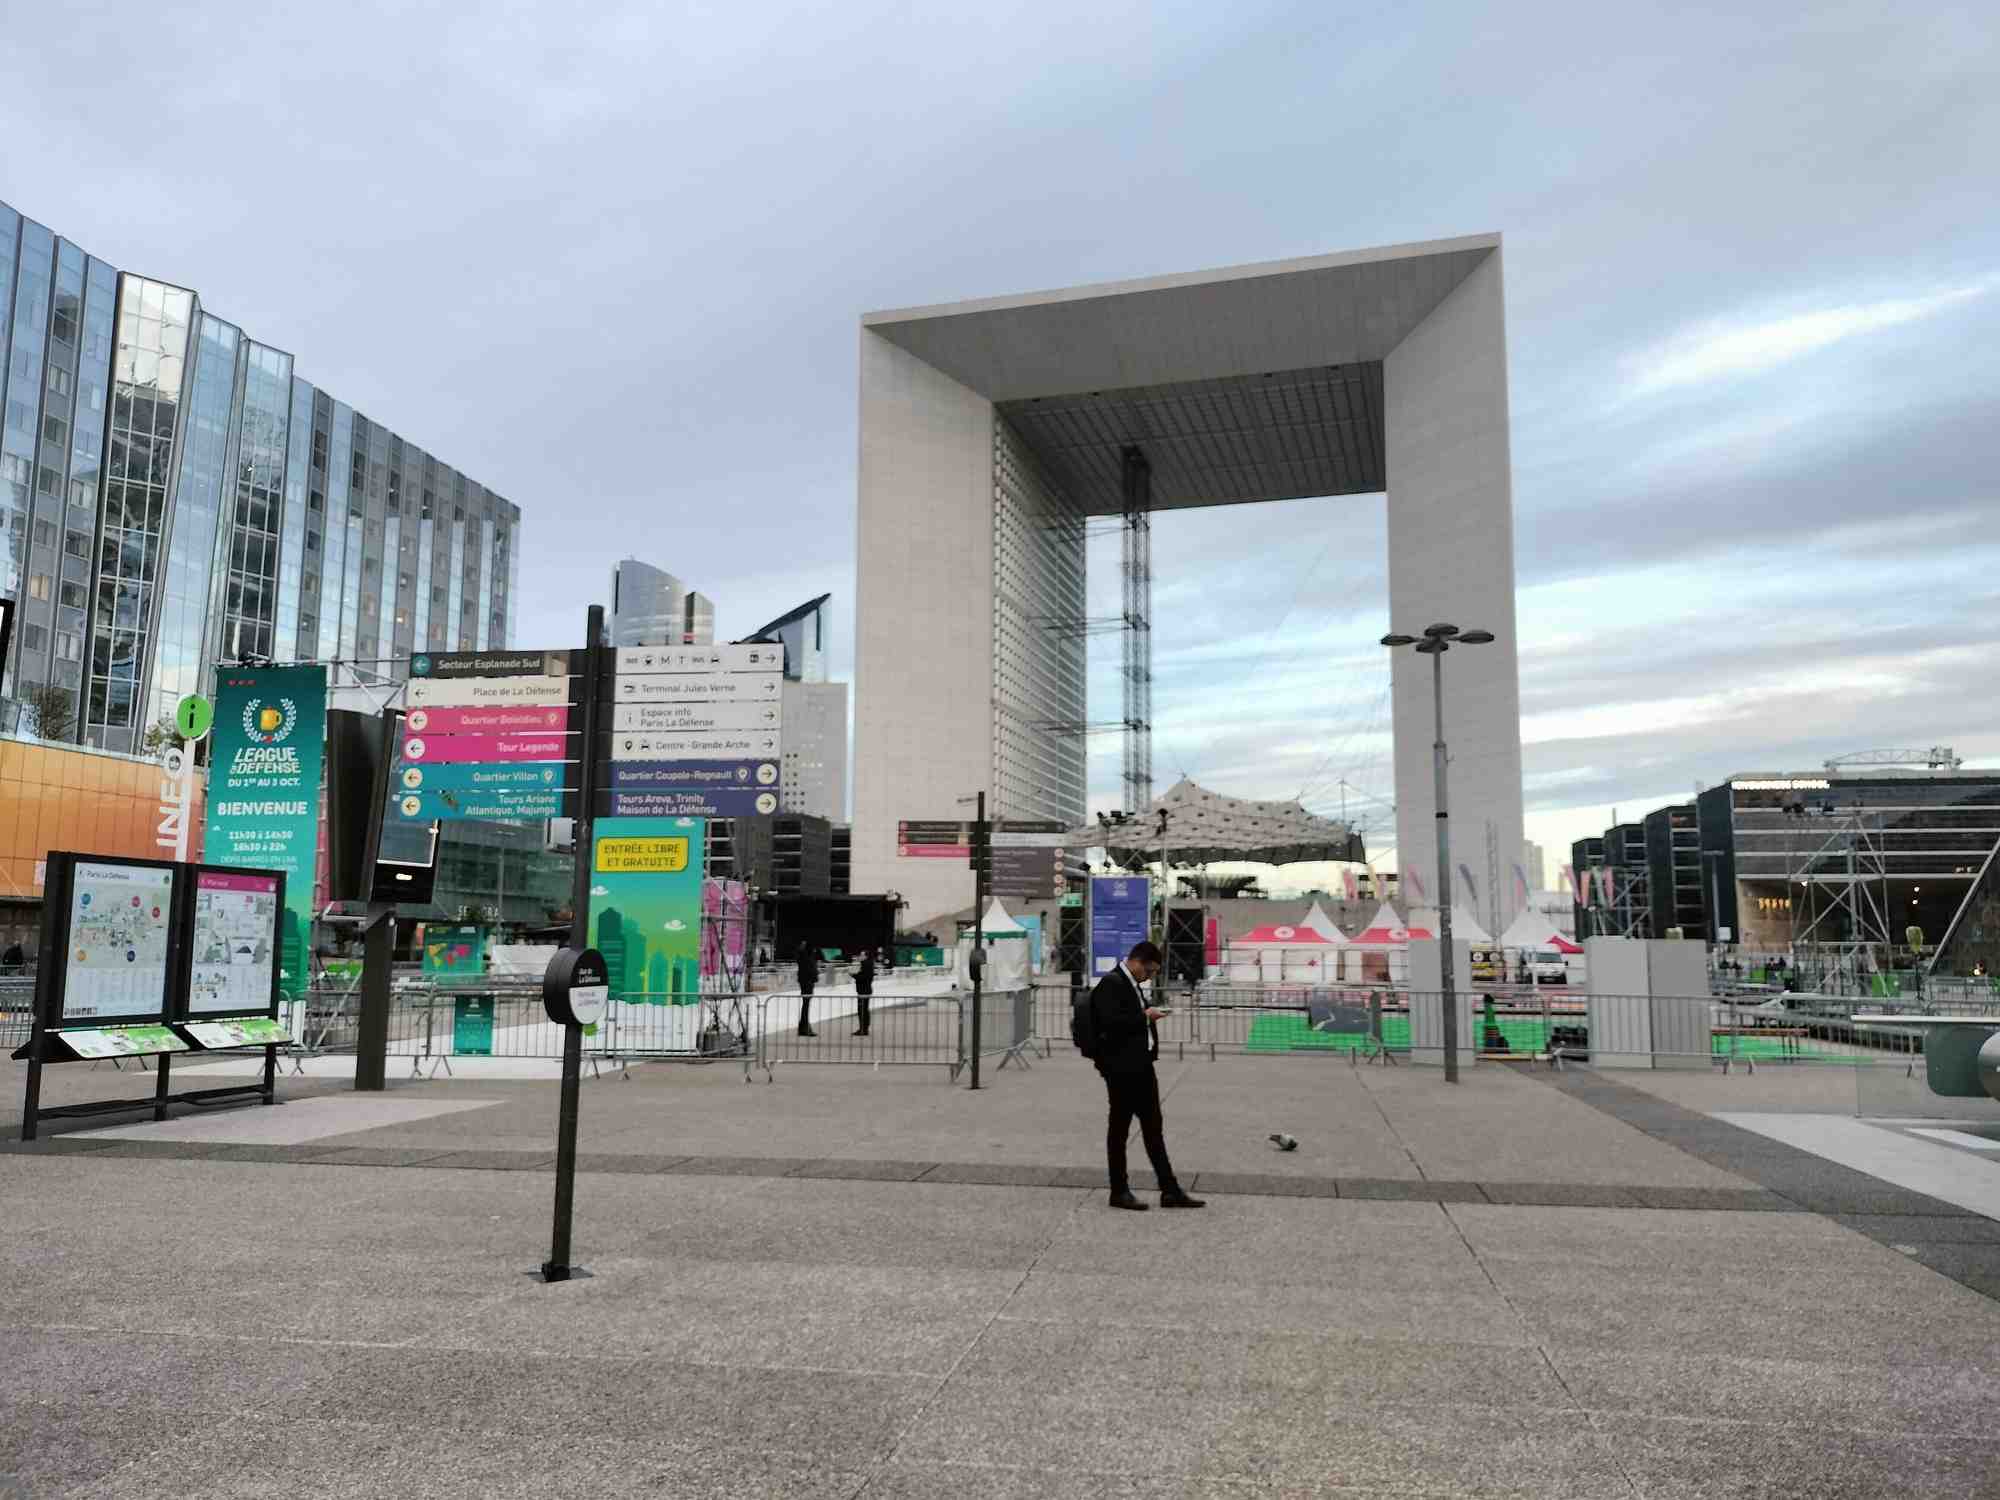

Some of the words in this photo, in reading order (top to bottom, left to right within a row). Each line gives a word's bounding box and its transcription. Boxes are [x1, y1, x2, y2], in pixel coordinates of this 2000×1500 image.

[437, 659, 472, 669] Secteur
[474, 658, 520, 670] Esplanade
[522, 657, 540, 668] Sud
[473, 687, 497, 697] Place
[500, 687, 510, 696] de
[513, 687, 524, 696] La
[641, 684, 680, 694] Terminal
[684, 683, 707, 694] Jules
[710, 682, 736, 693] Verne
[641, 707, 671, 719] Espace
[674, 706, 692, 716] info
[641, 718, 663, 728] Paris
[666, 718, 676, 727] La
[498, 742, 519, 753] Tour
[656, 741, 684, 750] Centre
[691, 740, 722, 749] Grande
[725, 739, 750, 749] Arche
[234, 747, 299, 762] LEAGUE
[236, 762, 302, 774] DEFENSE
[473, 772, 512, 784] Quartier
[513, 771, 538, 781] Villon
[618, 771, 654, 780] Quartier
[227, 778, 242, 787] DU
[257, 778, 270, 787] AU
[156, 748, 185, 847] INFO
[500, 795, 523, 804] Tours
[526, 793, 556, 804] Ariane
[617, 794, 643, 804] Tours
[677, 794, 705, 805] Trinity
[217, 801, 309, 816] BIENVENUE
[465, 805, 514, 817] Atlantique,
[517, 804, 556, 816] Majunga
[617, 804, 649, 815] Maison
[652, 804, 664, 814] de
[666, 804, 677, 814] La
[604, 842, 641, 854] ENTRÉE
[647, 843, 681, 854] LIBRE
[607, 857, 621, 867] ET
[623, 856, 675, 867] GRATUITE
